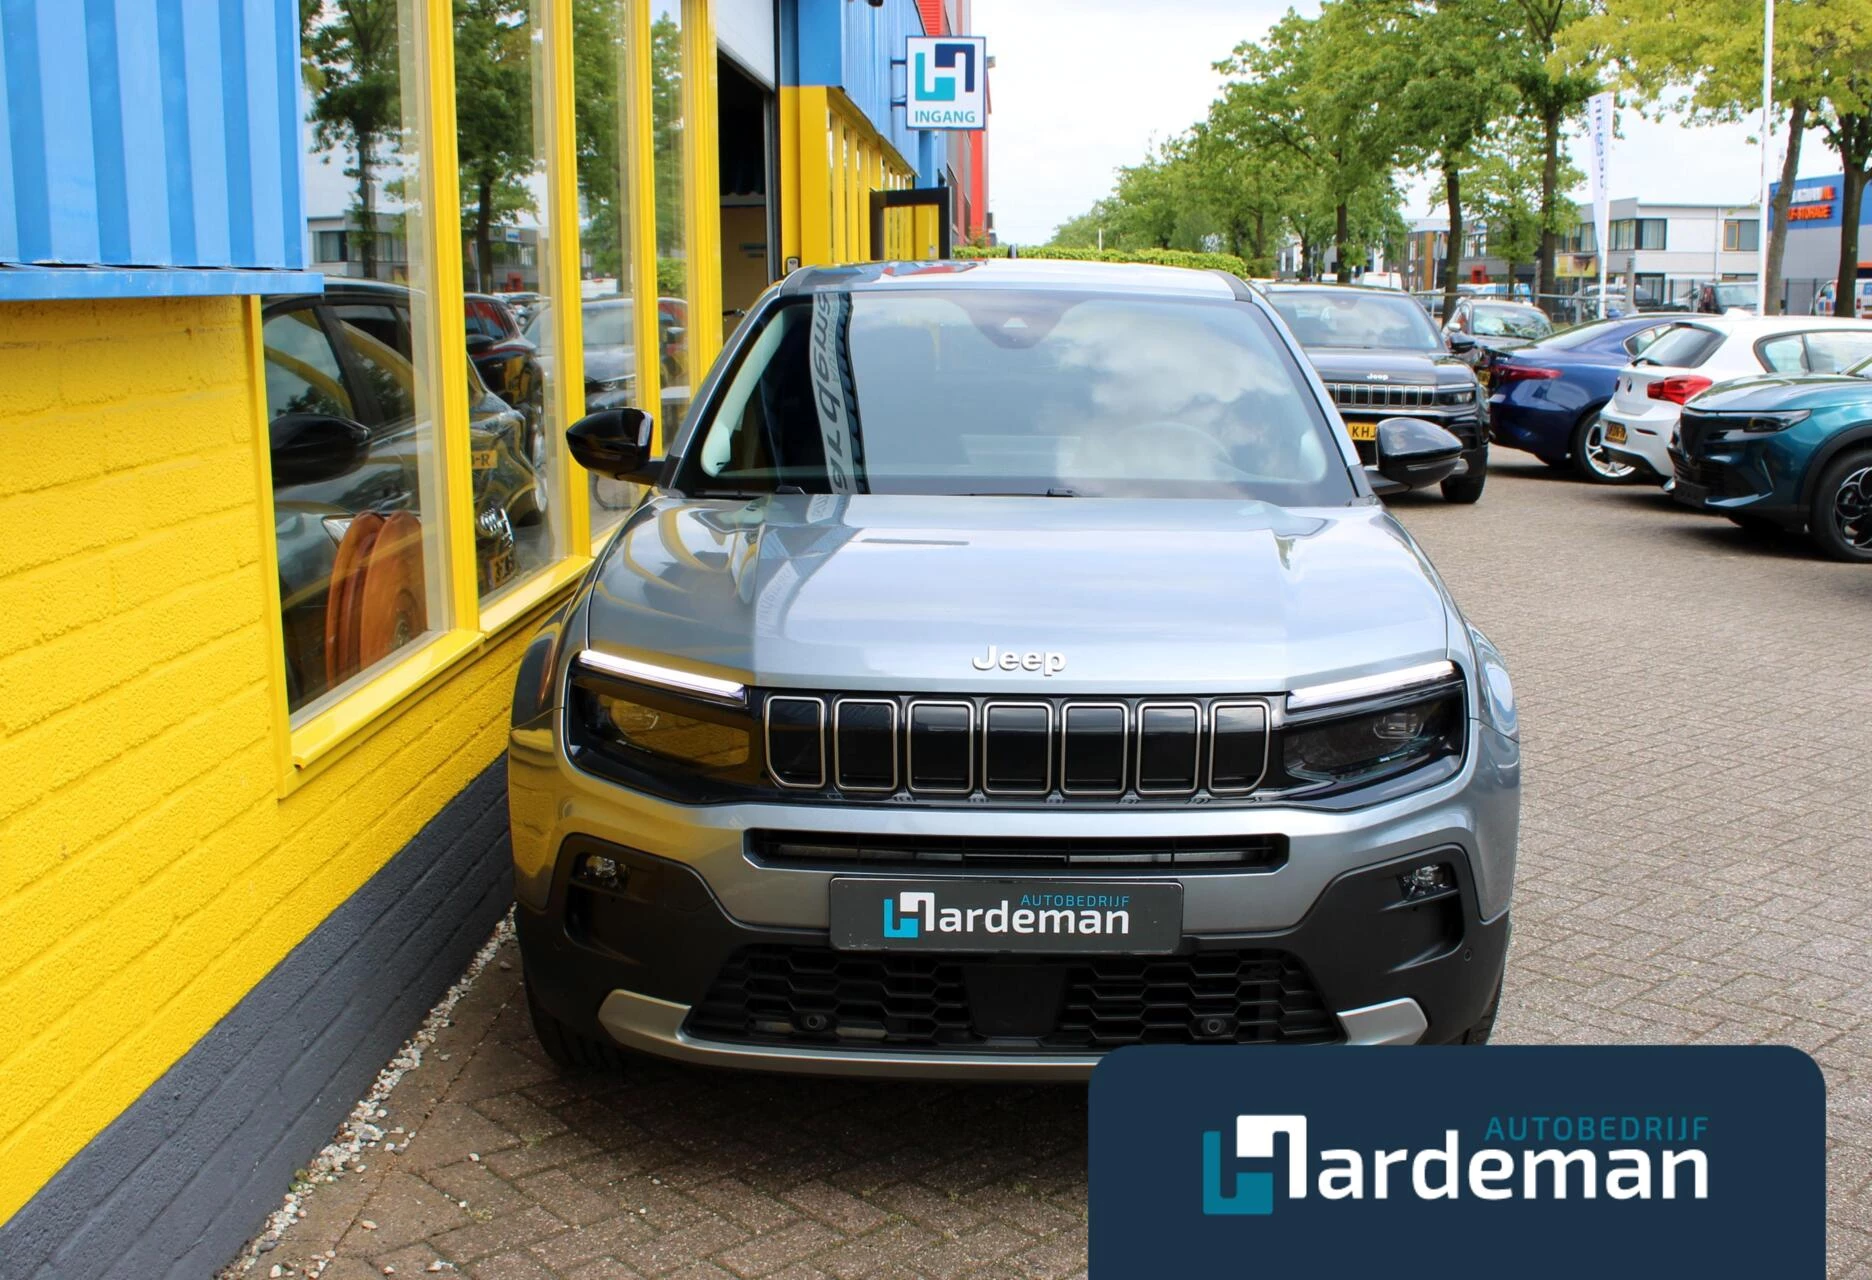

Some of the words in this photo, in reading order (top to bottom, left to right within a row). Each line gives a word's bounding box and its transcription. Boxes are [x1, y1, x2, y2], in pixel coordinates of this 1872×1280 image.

[914, 110, 976, 124] INGANG
[972, 645, 1067, 676] Jeep
[1020, 894, 1131, 908] AUTOBEDRIJF
